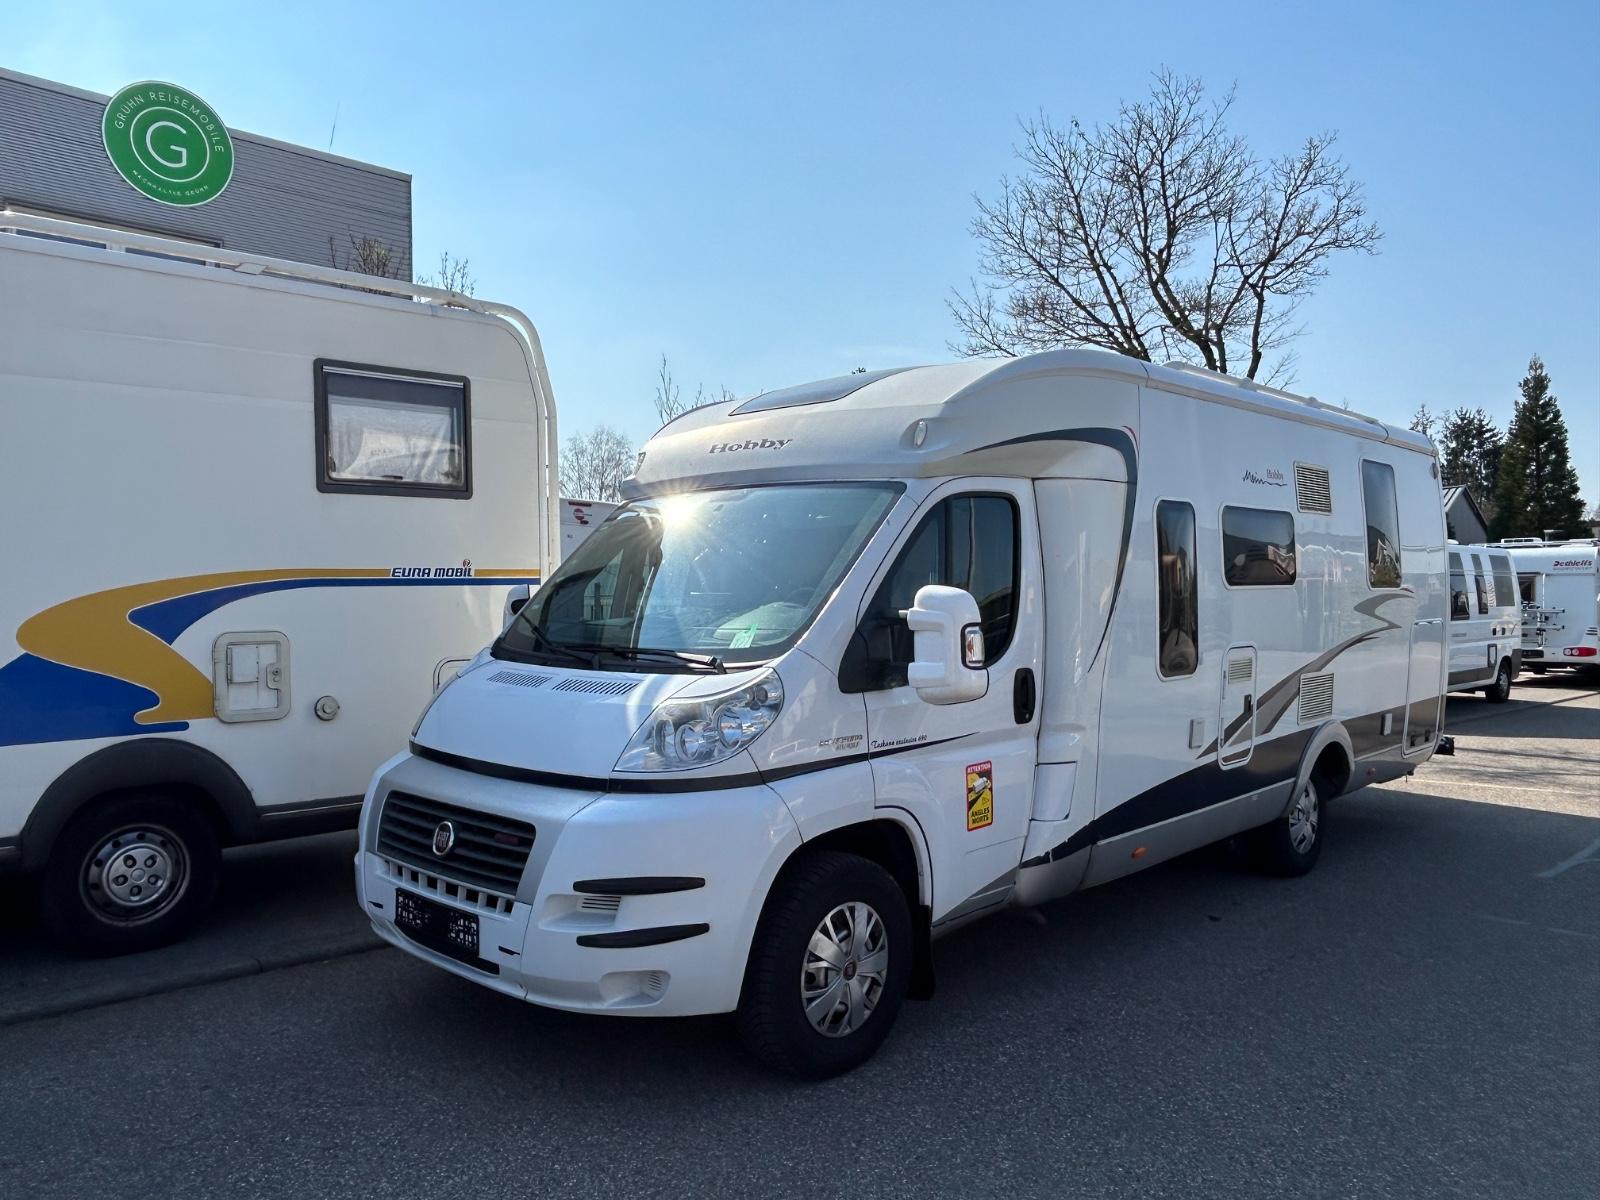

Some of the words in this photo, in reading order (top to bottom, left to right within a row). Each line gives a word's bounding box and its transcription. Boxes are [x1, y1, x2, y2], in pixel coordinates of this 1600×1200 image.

[115, 94, 145, 129] GRUHN
[149, 91, 224, 153] REISEMOBILE
[145, 121, 187, 168] G
[708, 438, 793, 454] Hobby
[391, 567, 431, 578] EURA
[433, 563, 473, 578] MOBIL
[971, 806, 990, 817] ANGLES
[971, 814, 990, 824] MORTS
